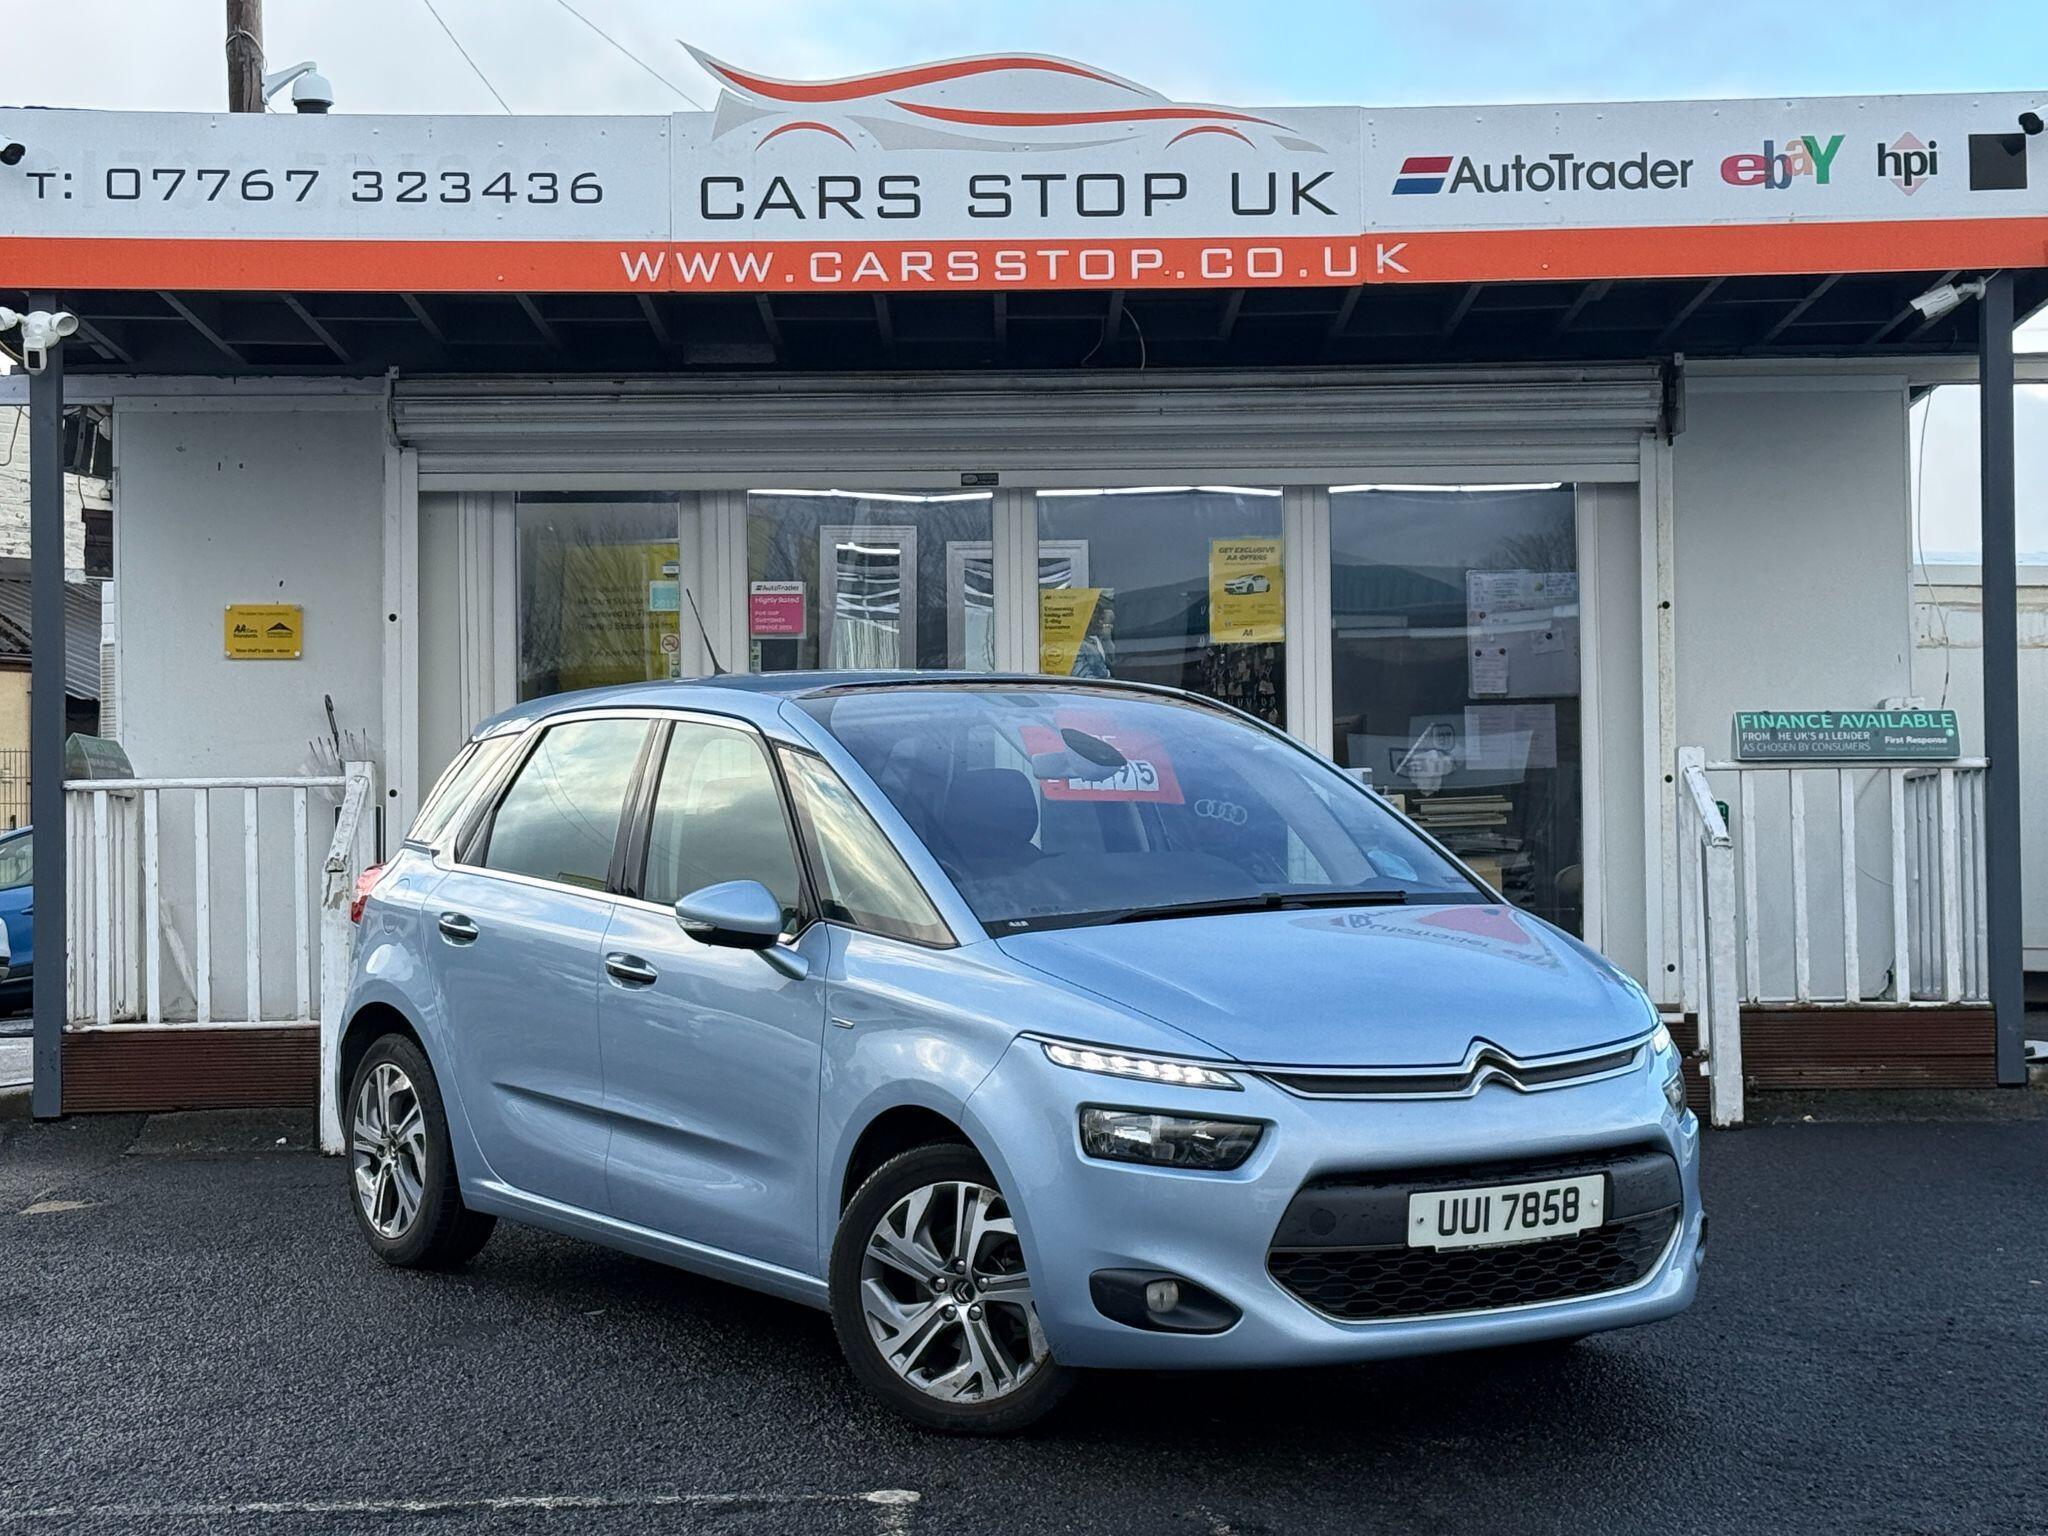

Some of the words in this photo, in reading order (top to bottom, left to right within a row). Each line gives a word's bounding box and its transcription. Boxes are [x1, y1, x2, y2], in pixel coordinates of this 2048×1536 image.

[1449, 152, 1694, 194] AutoTrader
[1877, 140, 1938, 187] hpi
[26, 172, 72, 200] T:
[105, 168, 320, 202] 07767
[351, 170, 604, 204] 323436
[700, 175, 922, 220] CARS
[967, 172, 1188, 218] STOP
[1231, 171, 1338, 216] UK
[620, 242, 1410, 285] WWW.CARSSTOP.CO.UK
[1740, 713, 1834, 729] FINANCE
[1839, 712, 1955, 729] AVAILABLE
[1742, 732, 1770, 741] FROM
[1794, 731, 1817, 741] UK'S
[1832, 731, 1871, 741] LENDER
[1742, 742, 1756, 752] AS
[1757, 742, 1797, 752] CHOSEN
[1798, 742, 1811, 752] BY
[1812, 741, 1871, 752] CONSUMERS
[1884, 735, 1904, 745] First
[1906, 735, 1949, 746] Response
[1437, 1195, 1491, 1237] UUI
[1501, 1186, 1581, 1231] 7858
